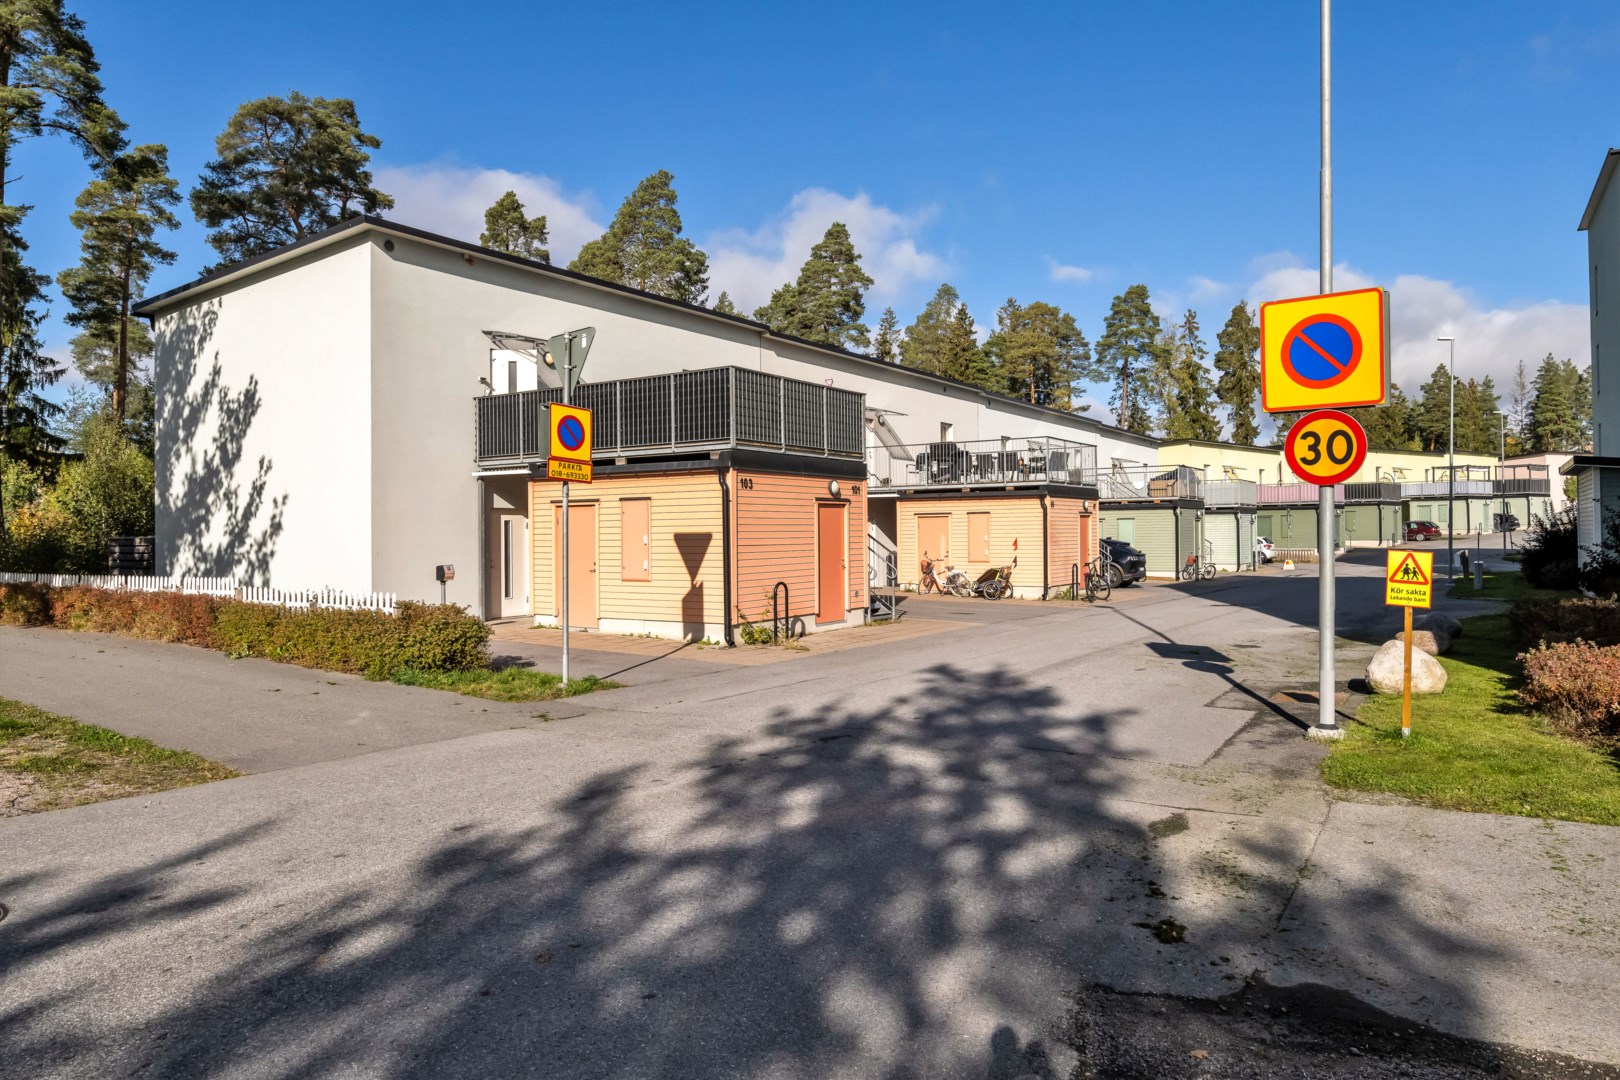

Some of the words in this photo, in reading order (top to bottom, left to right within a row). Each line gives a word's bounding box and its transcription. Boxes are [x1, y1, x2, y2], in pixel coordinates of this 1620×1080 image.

[1299, 429, 1354, 466] 30
[551, 470, 589, 480] 018-693330
[740, 477, 753, 490] 103
[1390, 587, 1404, 595] Kör
